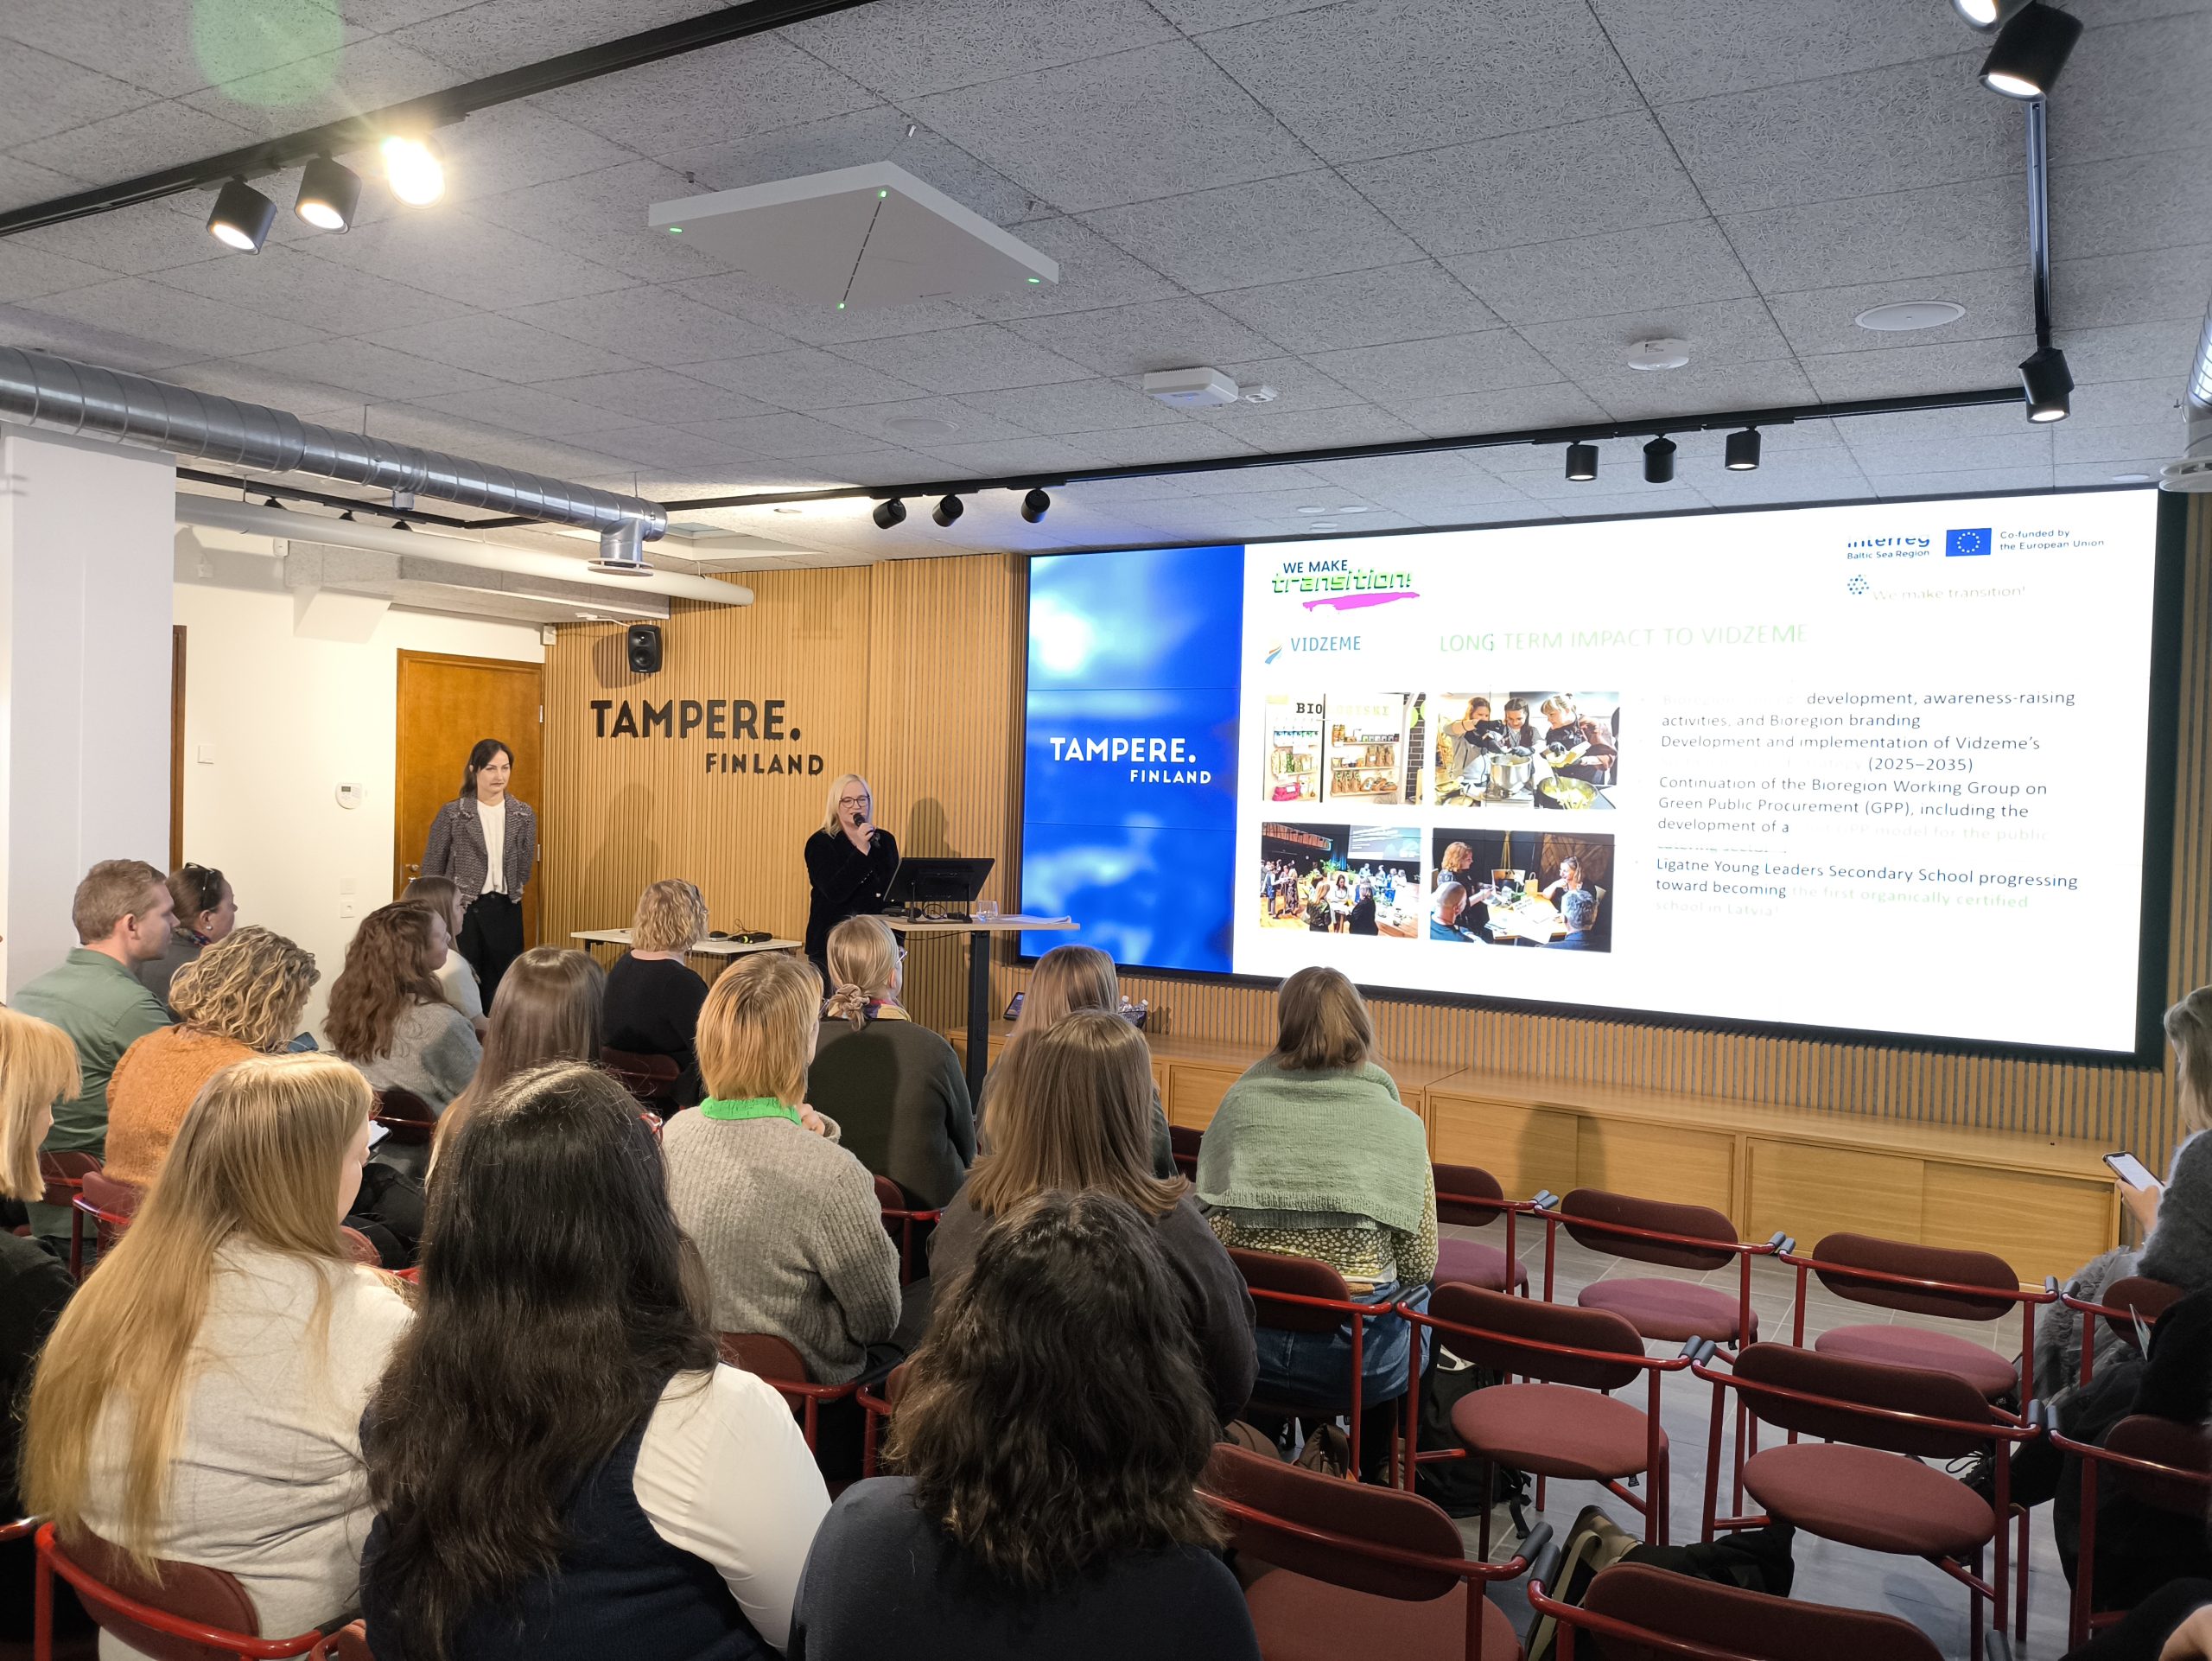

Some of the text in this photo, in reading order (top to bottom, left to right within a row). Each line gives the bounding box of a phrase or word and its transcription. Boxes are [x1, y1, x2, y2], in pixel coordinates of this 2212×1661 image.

[1999, 529, 2070, 539] Co-funded by
[2019, 541, 2069, 550] European
[2073, 539, 2105, 548] Union
[1895, 549, 1929, 558] Region
[1283, 559, 1348, 574] WE MAKE
[1272, 570, 1412, 594] transition!
[1291, 636, 1361, 652] VIDZEME
[1440, 624, 1808, 652] LONG TERM IMPACT TO VIDZEME
[1807, 692, 1917, 707] development,
[1923, 691, 2075, 707] awareness-raising
[590, 699, 801, 741] TAMPERE.
[1662, 714, 1921, 729] activities, and Bioregion branding
[1050, 737, 1197, 763] TAMPERE.
[1662, 735, 1760, 749] Development
[1766, 735, 1794, 748] and
[1800, 735, 1928, 750] implementation
[1934, 736, 1950, 748] of
[706, 753, 823, 775] FINLAND
[1130, 769, 1211, 784] FINLAND
[1659, 776, 2047, 797] Continuation of the Bioregion Working Group on
[1659, 797, 2029, 820] Green Public Procurement (GPP), including the
[1657, 818, 1757, 833] development
[1761, 819, 1777, 832] of
[1782, 823, 1789, 833] a
[1656, 857, 2078, 890] Ligatne Young Leaders Secondary School progressing
[1656, 879, 2029, 908] toward becoming the first organically certified
